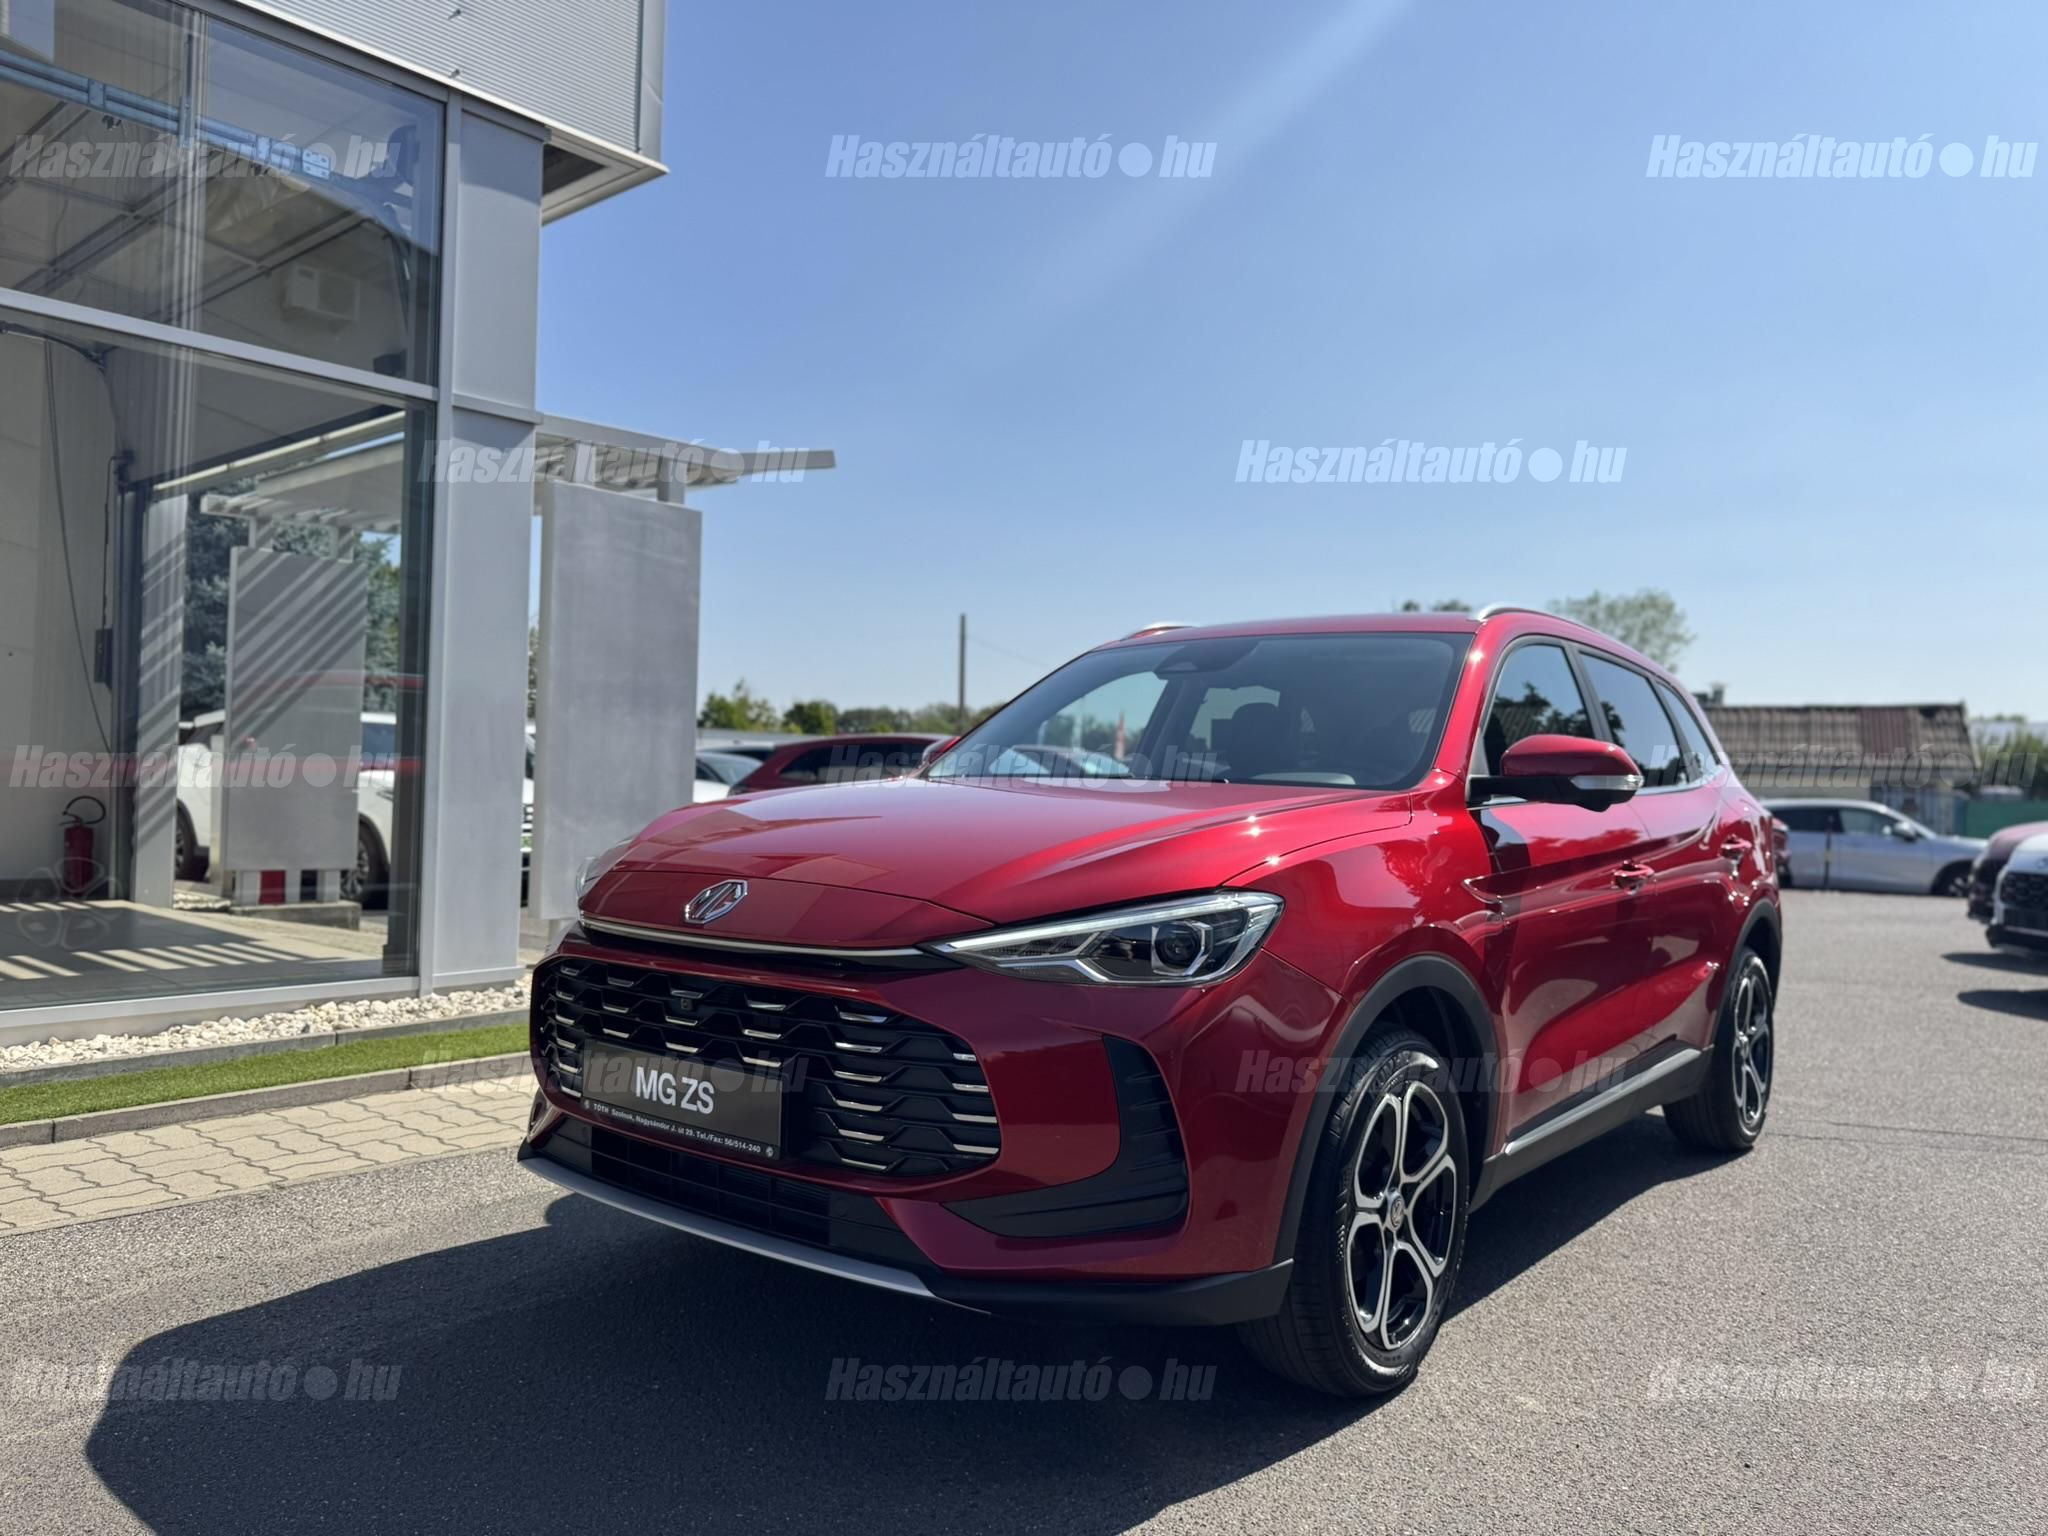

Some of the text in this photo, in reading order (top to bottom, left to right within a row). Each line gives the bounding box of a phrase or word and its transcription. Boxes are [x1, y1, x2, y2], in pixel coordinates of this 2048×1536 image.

[685, 879, 748, 924] MG
[636, 1066, 715, 1115] MG ZS
